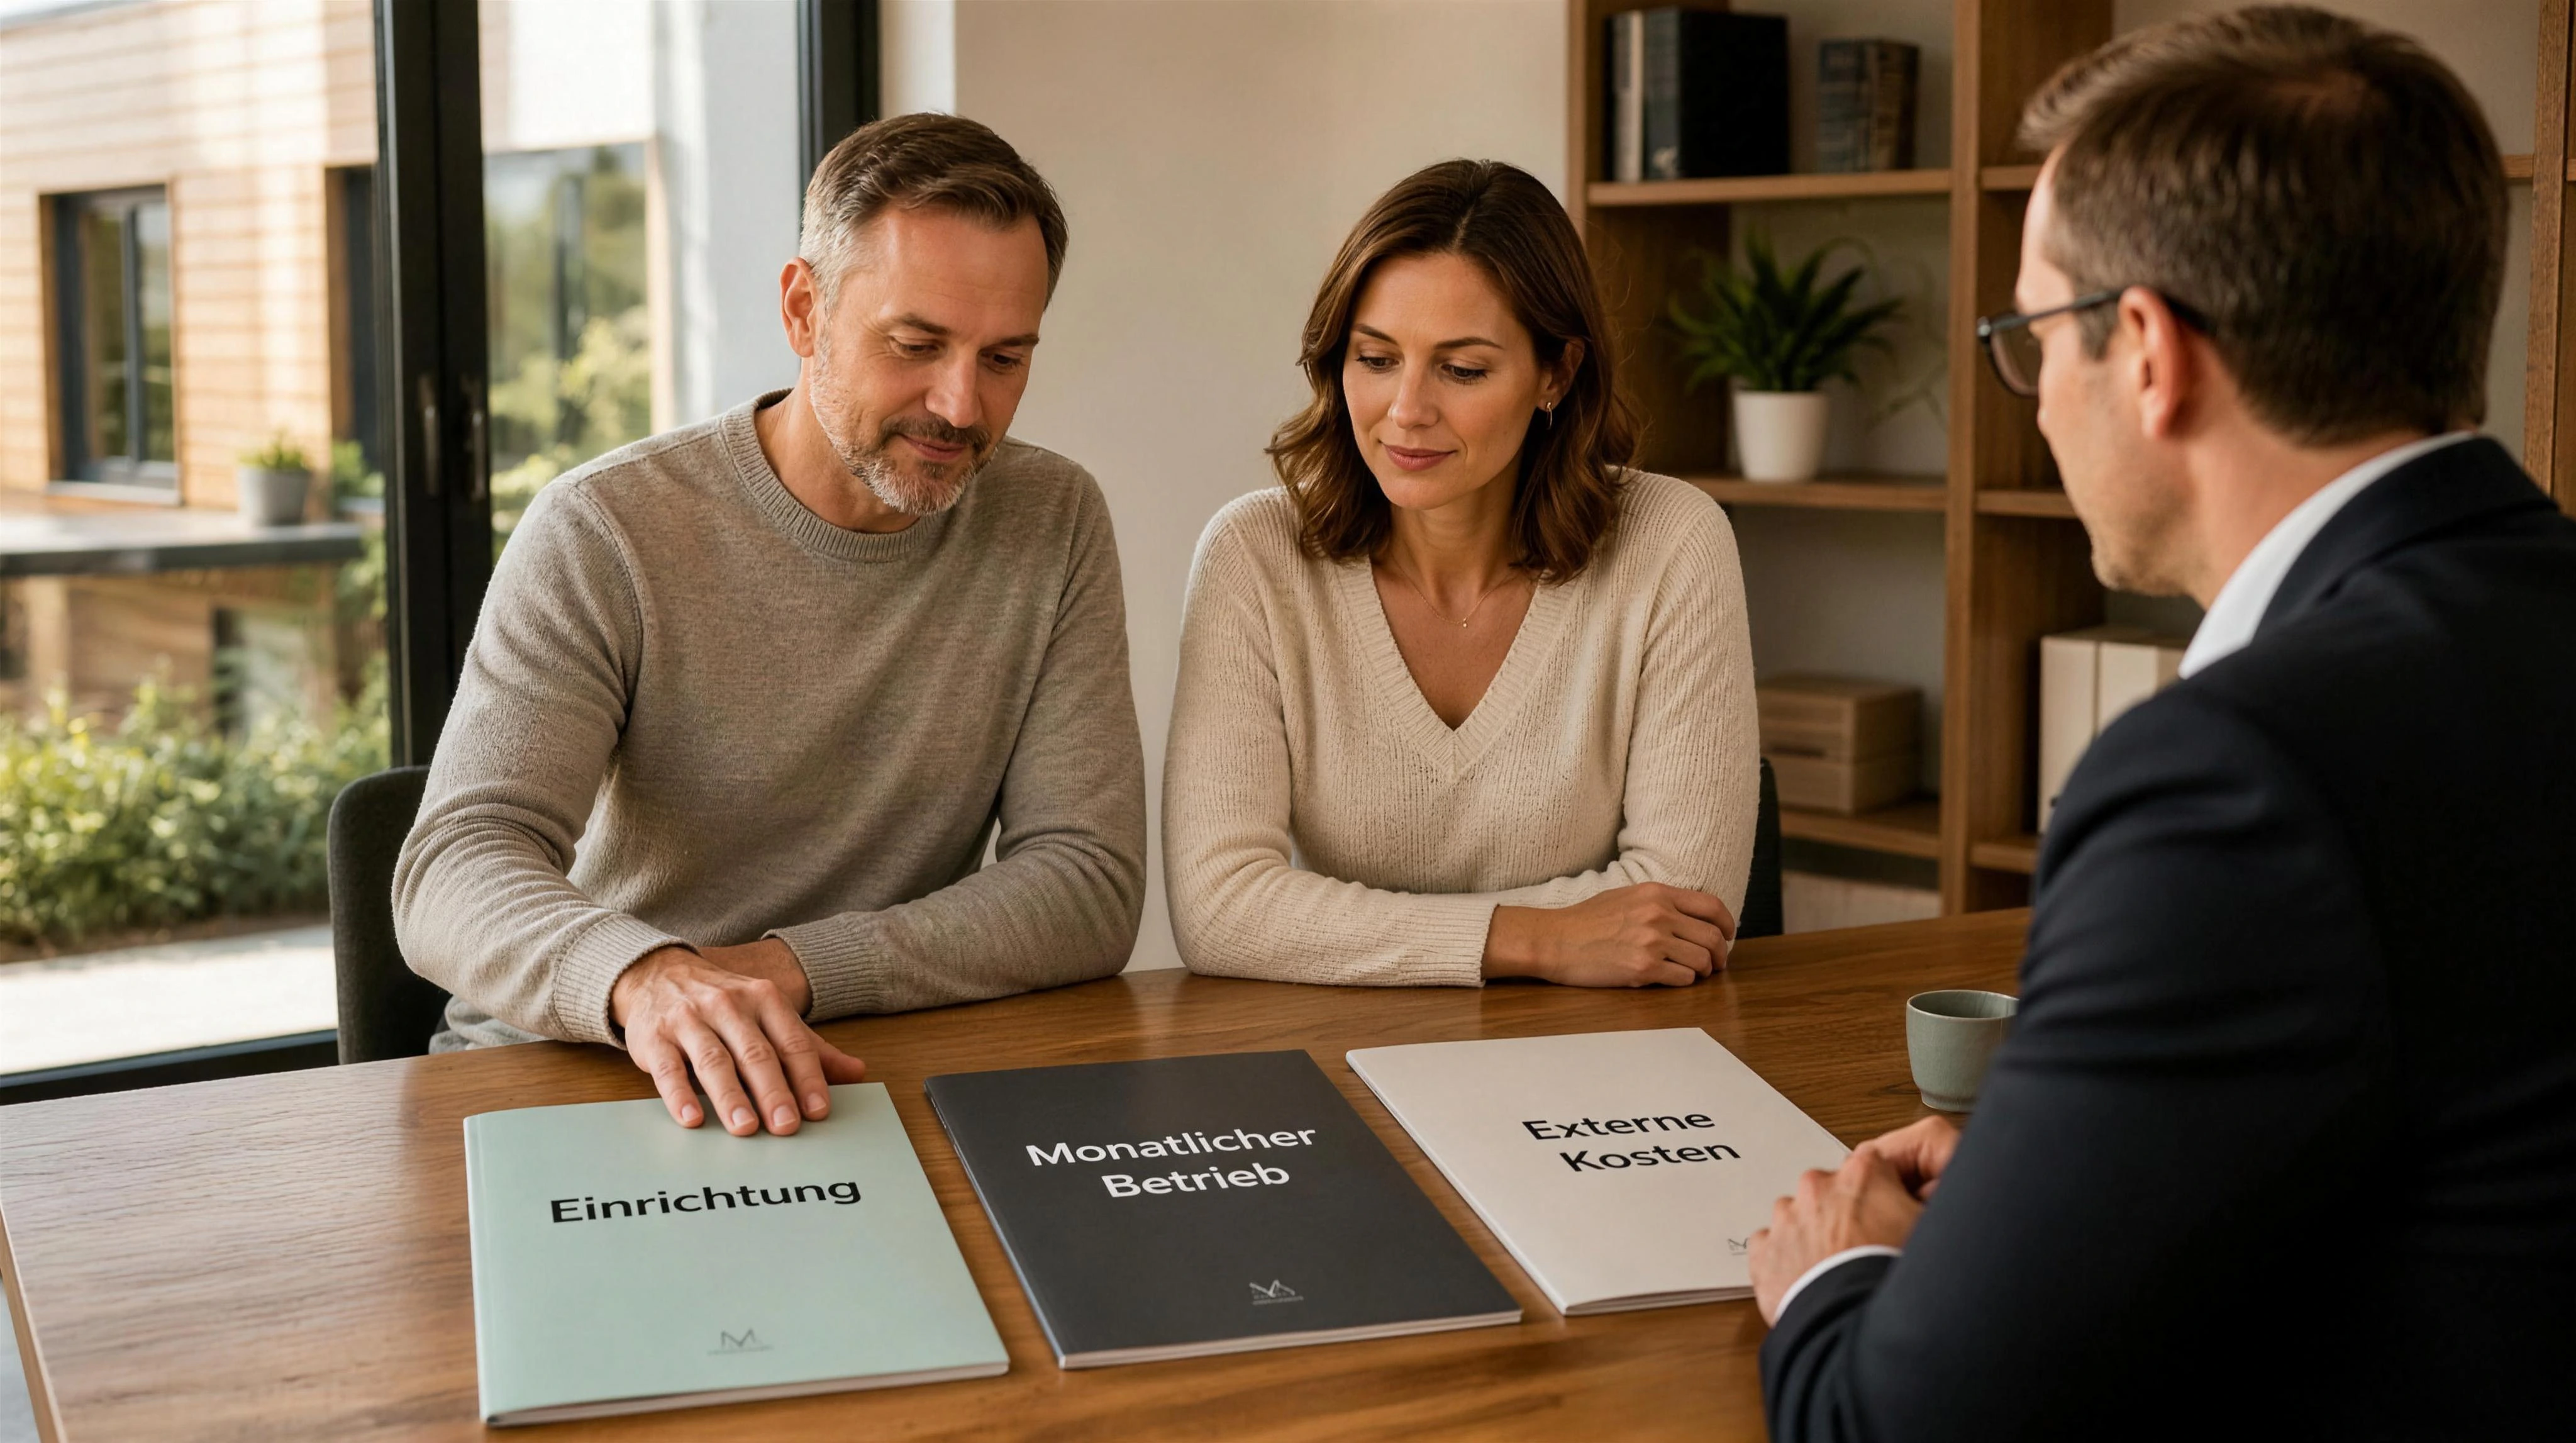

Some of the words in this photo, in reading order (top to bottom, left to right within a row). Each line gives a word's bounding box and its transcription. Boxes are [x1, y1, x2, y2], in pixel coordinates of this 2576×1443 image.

[1521, 1113, 1716, 1140] Externe
[1024, 1128, 1316, 1167] Monatlicher
[1558, 1145, 1741, 1173] Kosten
[1101, 1162, 1291, 1198] Betrieb
[550, 1181, 862, 1223] Einrichtung
